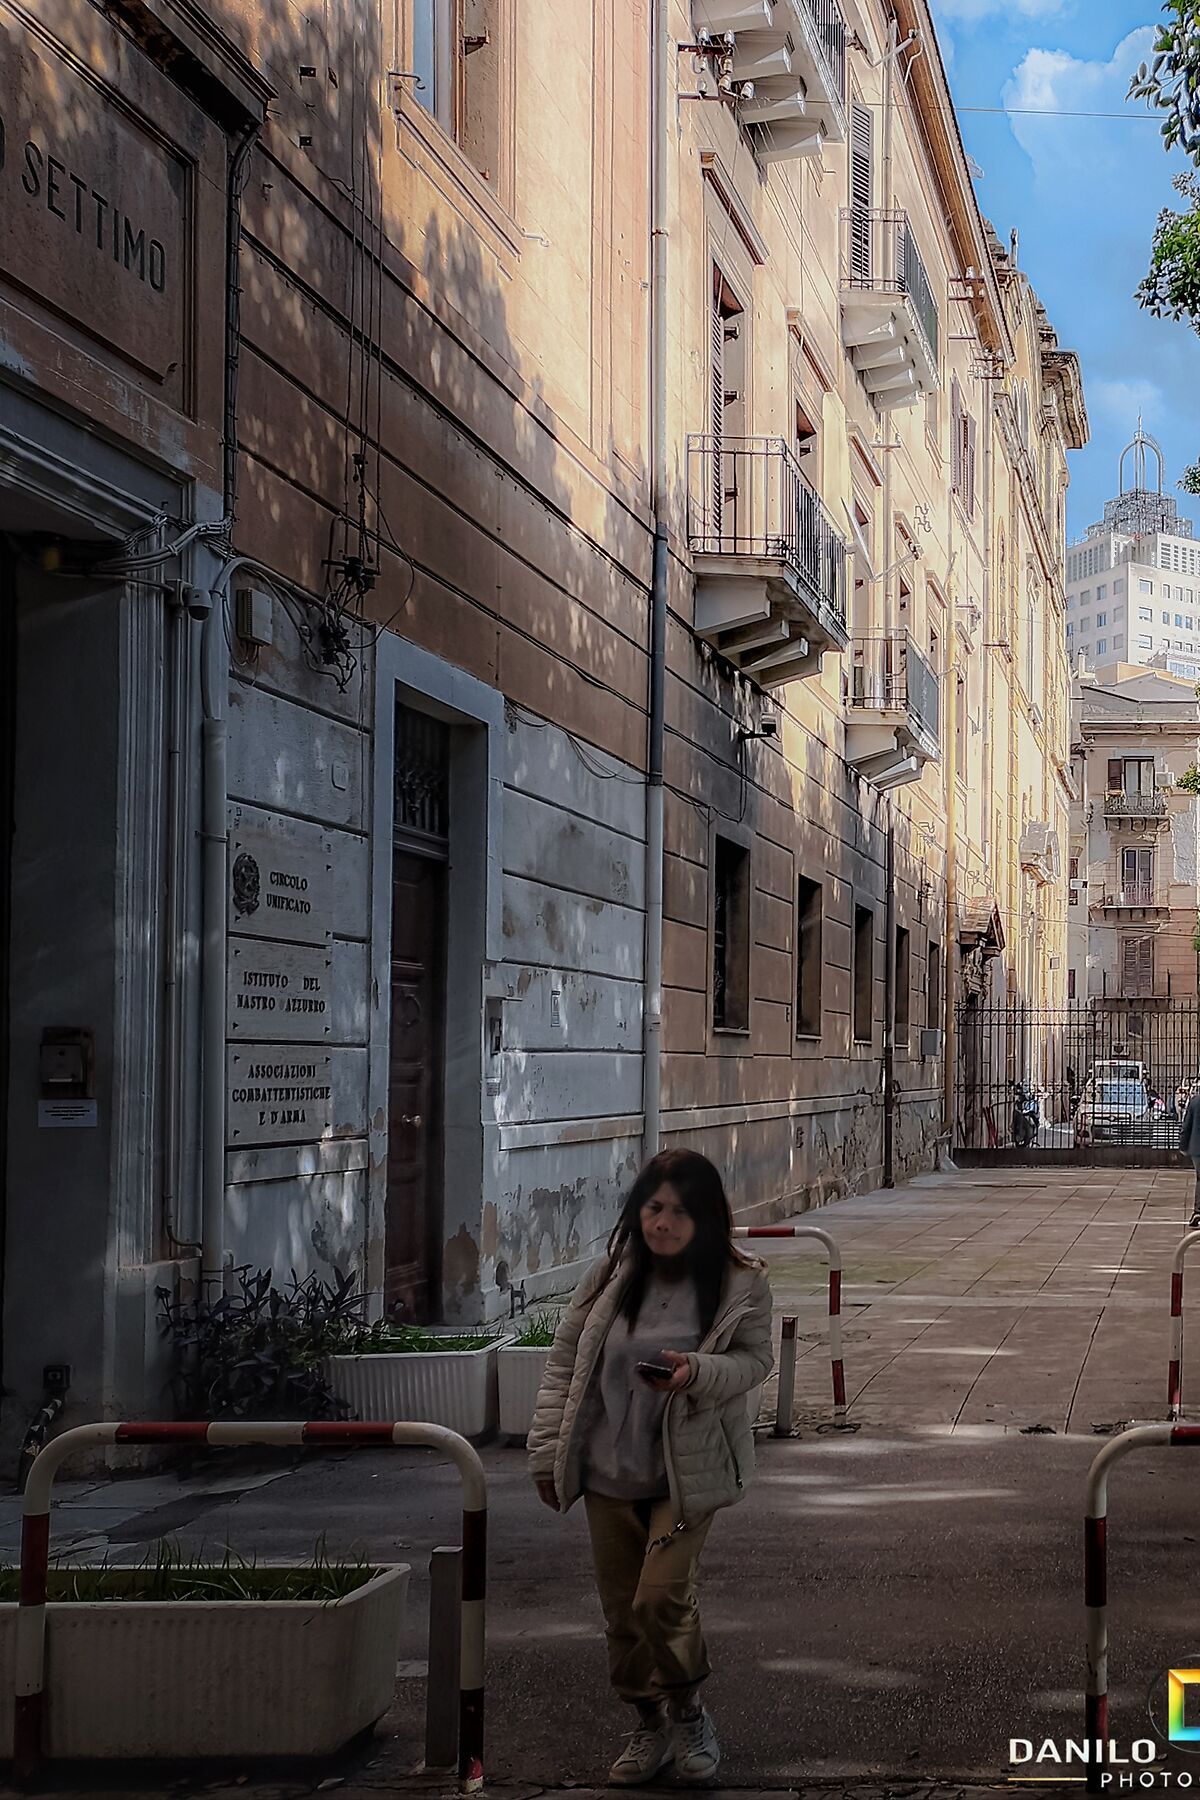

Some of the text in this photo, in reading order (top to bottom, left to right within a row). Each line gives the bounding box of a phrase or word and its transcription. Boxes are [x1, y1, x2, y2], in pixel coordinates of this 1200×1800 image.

[21, 141, 166, 293] SETTIMO
[269, 871, 308, 892] CIRCOLO
[266, 893, 311, 915] UNIFICATO
[243, 971, 321, 992] ISTITUTO DEL
[236, 994, 326, 1014] NASTRO AZZURRO
[247, 1064, 316, 1079] ASSOCIAZIONI
[232, 1086, 331, 1103] COMBATTENTISTICHE
[258, 1111, 266, 1126] E
